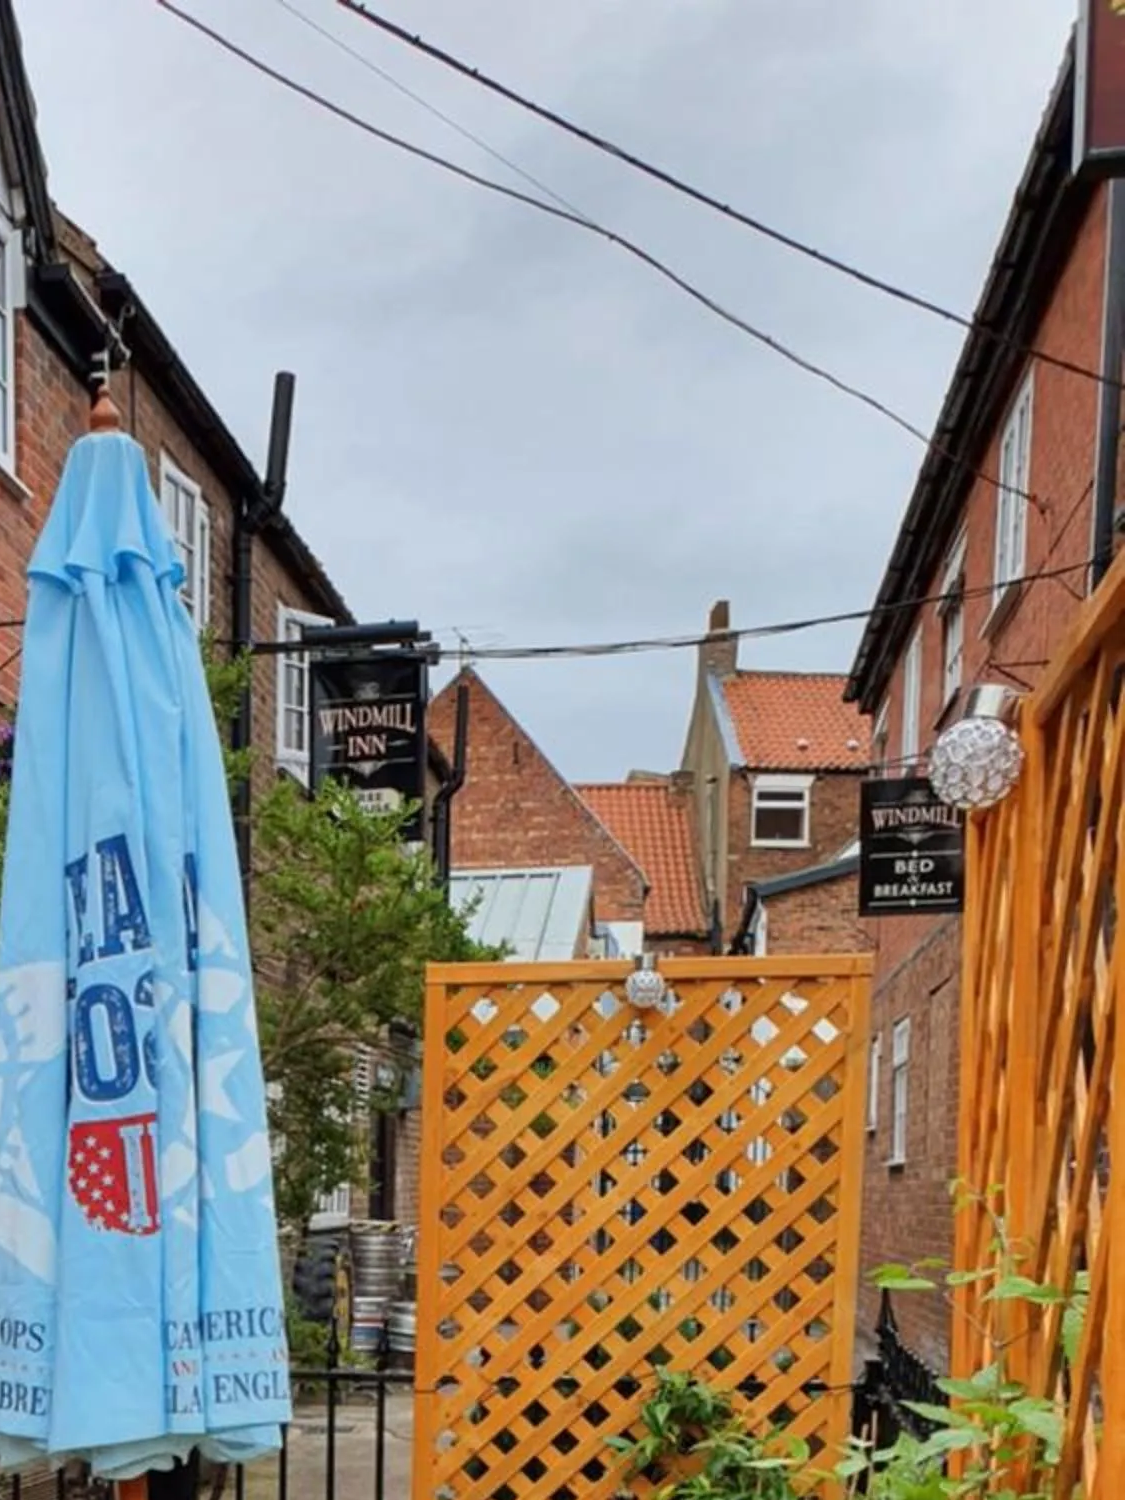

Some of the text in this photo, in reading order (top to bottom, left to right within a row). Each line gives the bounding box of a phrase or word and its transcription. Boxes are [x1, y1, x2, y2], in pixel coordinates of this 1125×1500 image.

[318, 704, 416, 736] WINDMILL
[348, 734, 387, 757] INN
[871, 805, 963, 831] WINDMILL
[894, 859, 935, 874] BED
[873, 882, 954, 898] BREAKFAST
